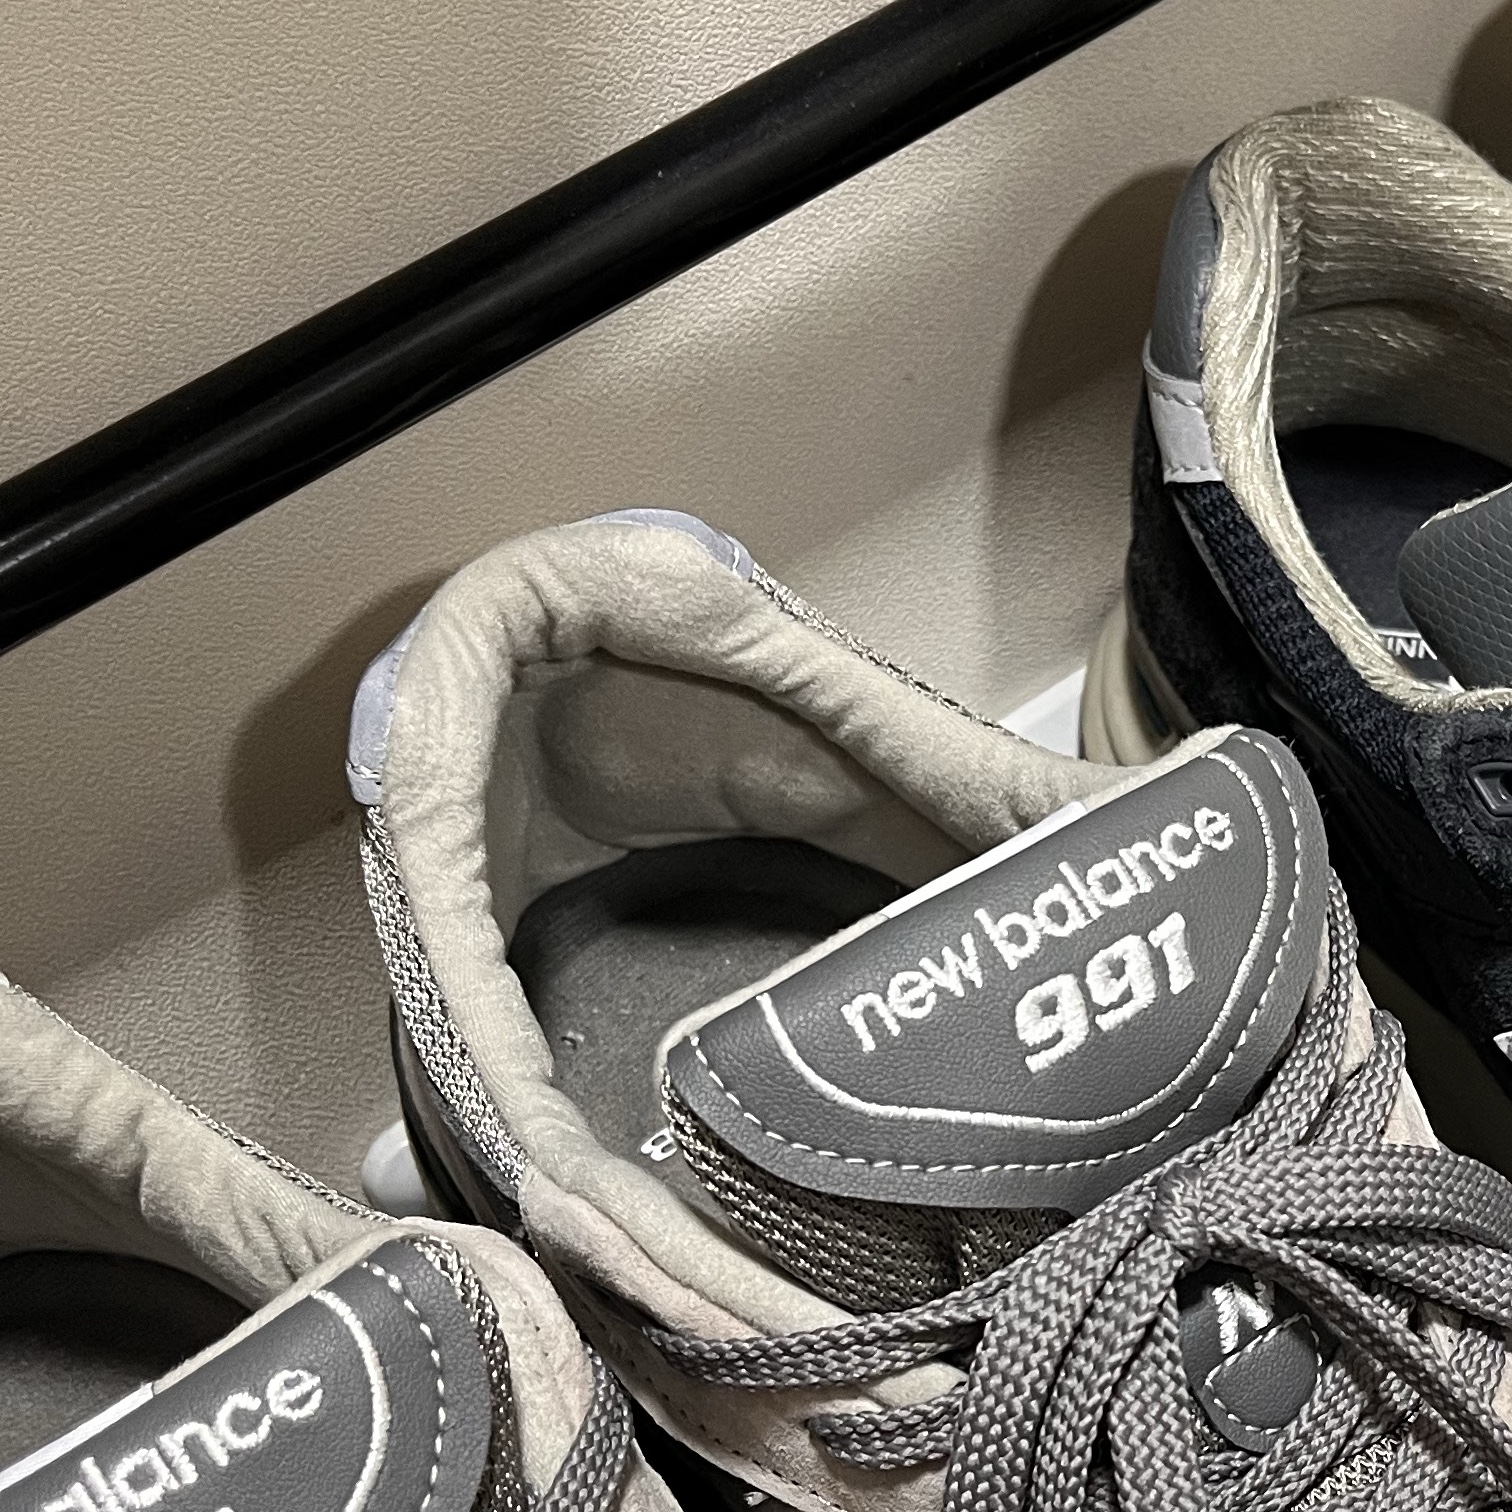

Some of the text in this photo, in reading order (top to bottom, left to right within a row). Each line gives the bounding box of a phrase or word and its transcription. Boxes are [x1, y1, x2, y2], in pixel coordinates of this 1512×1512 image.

[840, 806, 1235, 1053] new balance
[1014, 911, 1196, 1073] 991
